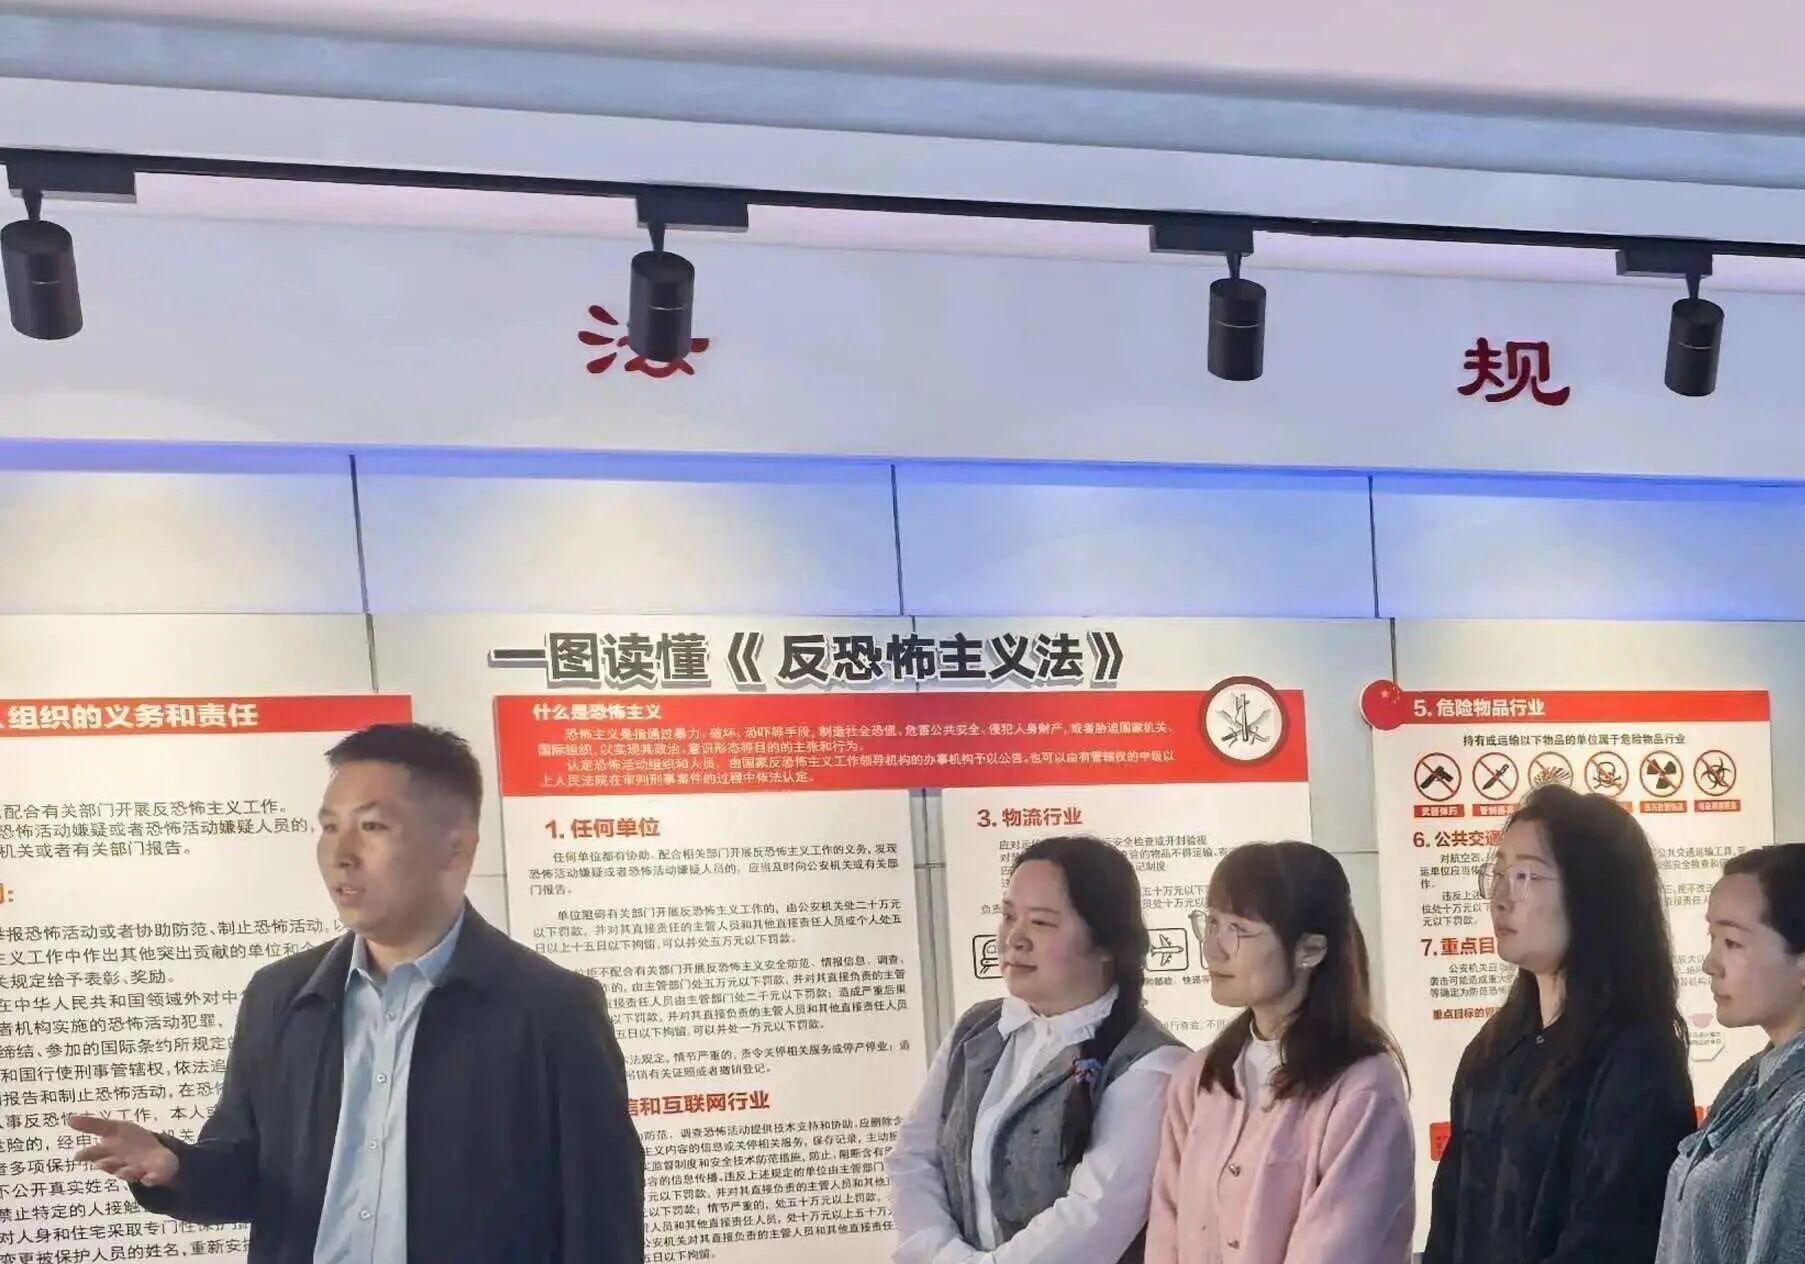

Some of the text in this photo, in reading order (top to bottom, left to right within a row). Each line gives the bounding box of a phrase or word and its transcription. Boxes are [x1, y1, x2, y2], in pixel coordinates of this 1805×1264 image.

[1458, 336, 1570, 405] 规
[491, 631, 1124, 686] 一图读懂《反恐怖主义法》
[0, 703, 258, 729] 组织的义务和责任
[532, 703, 662, 720] 什么是恐怖主义
[0, 799, 287, 820] 配合有关部门开展反恐怖主义工作。
[0, 990, 243, 1013] 在中华人民共和国领域外对中
[0, 1081, 223, 1106] 报告和制止恐怖活动,在恐
